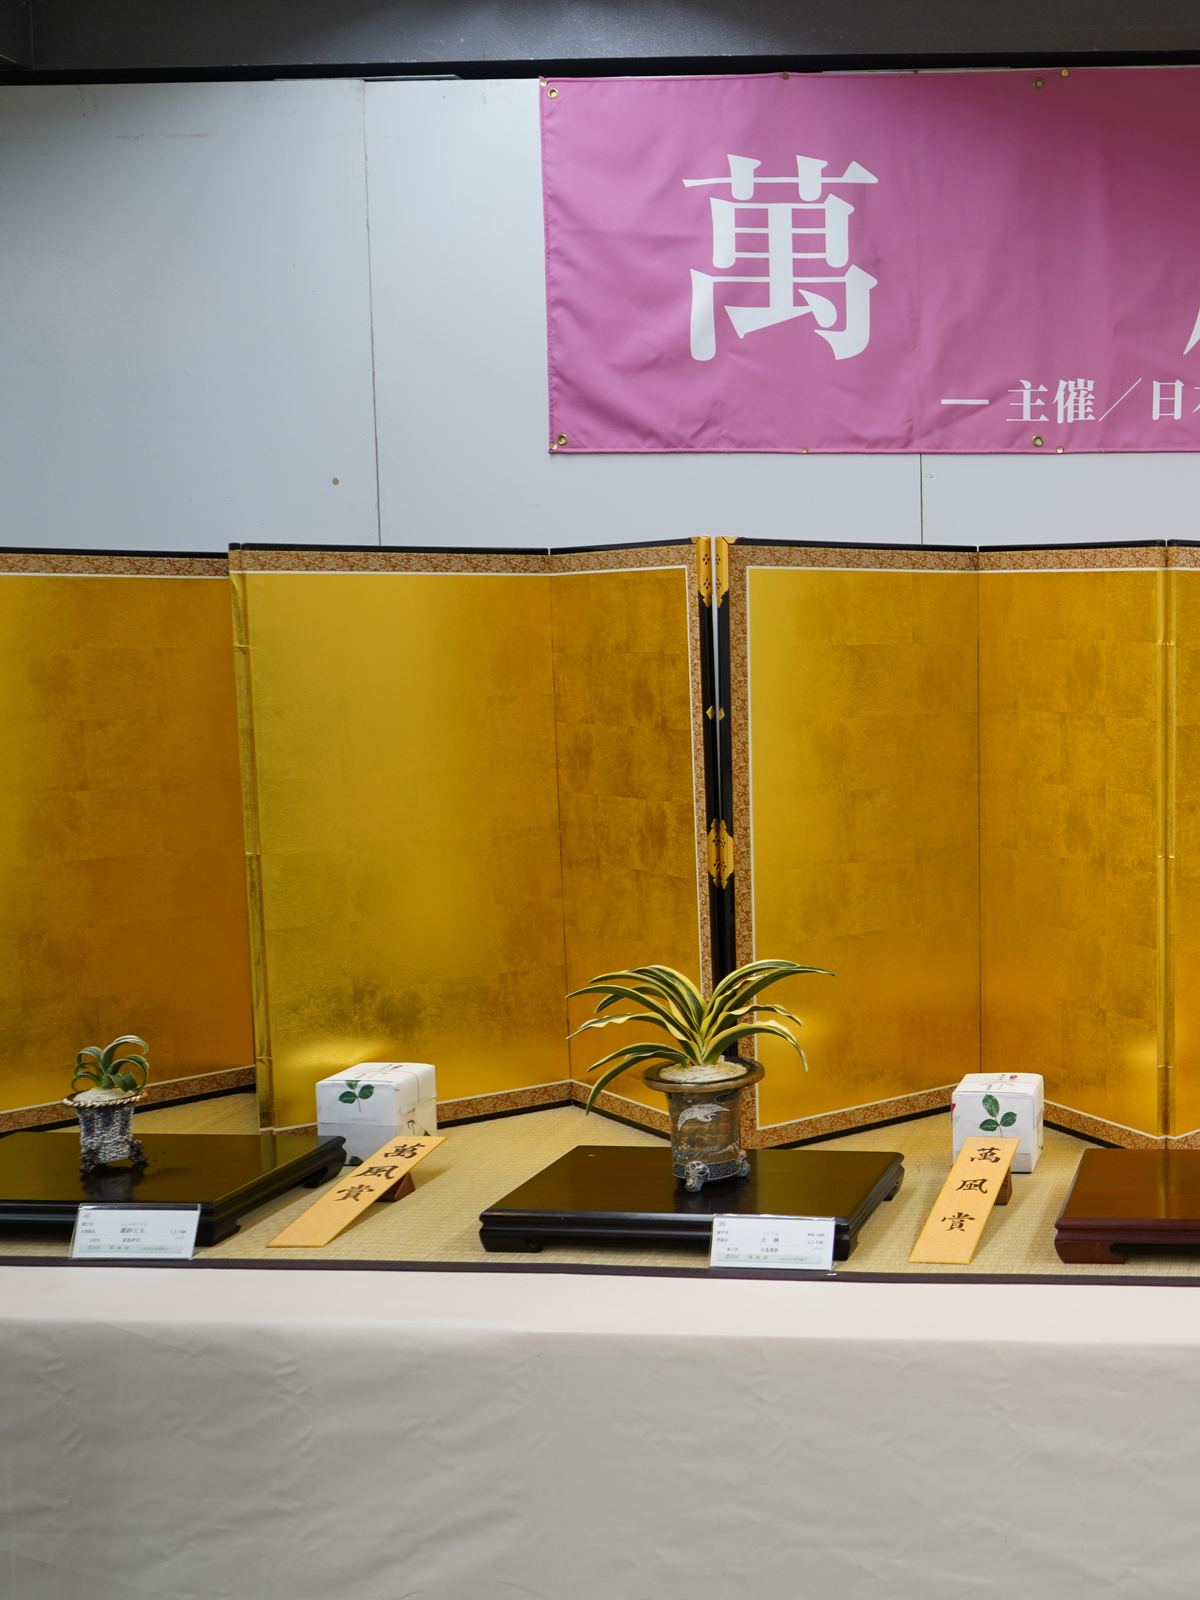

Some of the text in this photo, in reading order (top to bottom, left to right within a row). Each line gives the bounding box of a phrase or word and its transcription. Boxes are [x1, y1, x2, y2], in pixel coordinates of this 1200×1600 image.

[333, 1143, 425, 1202] 萬風賞
[941, 1147, 1001, 1232] 萬風賞
